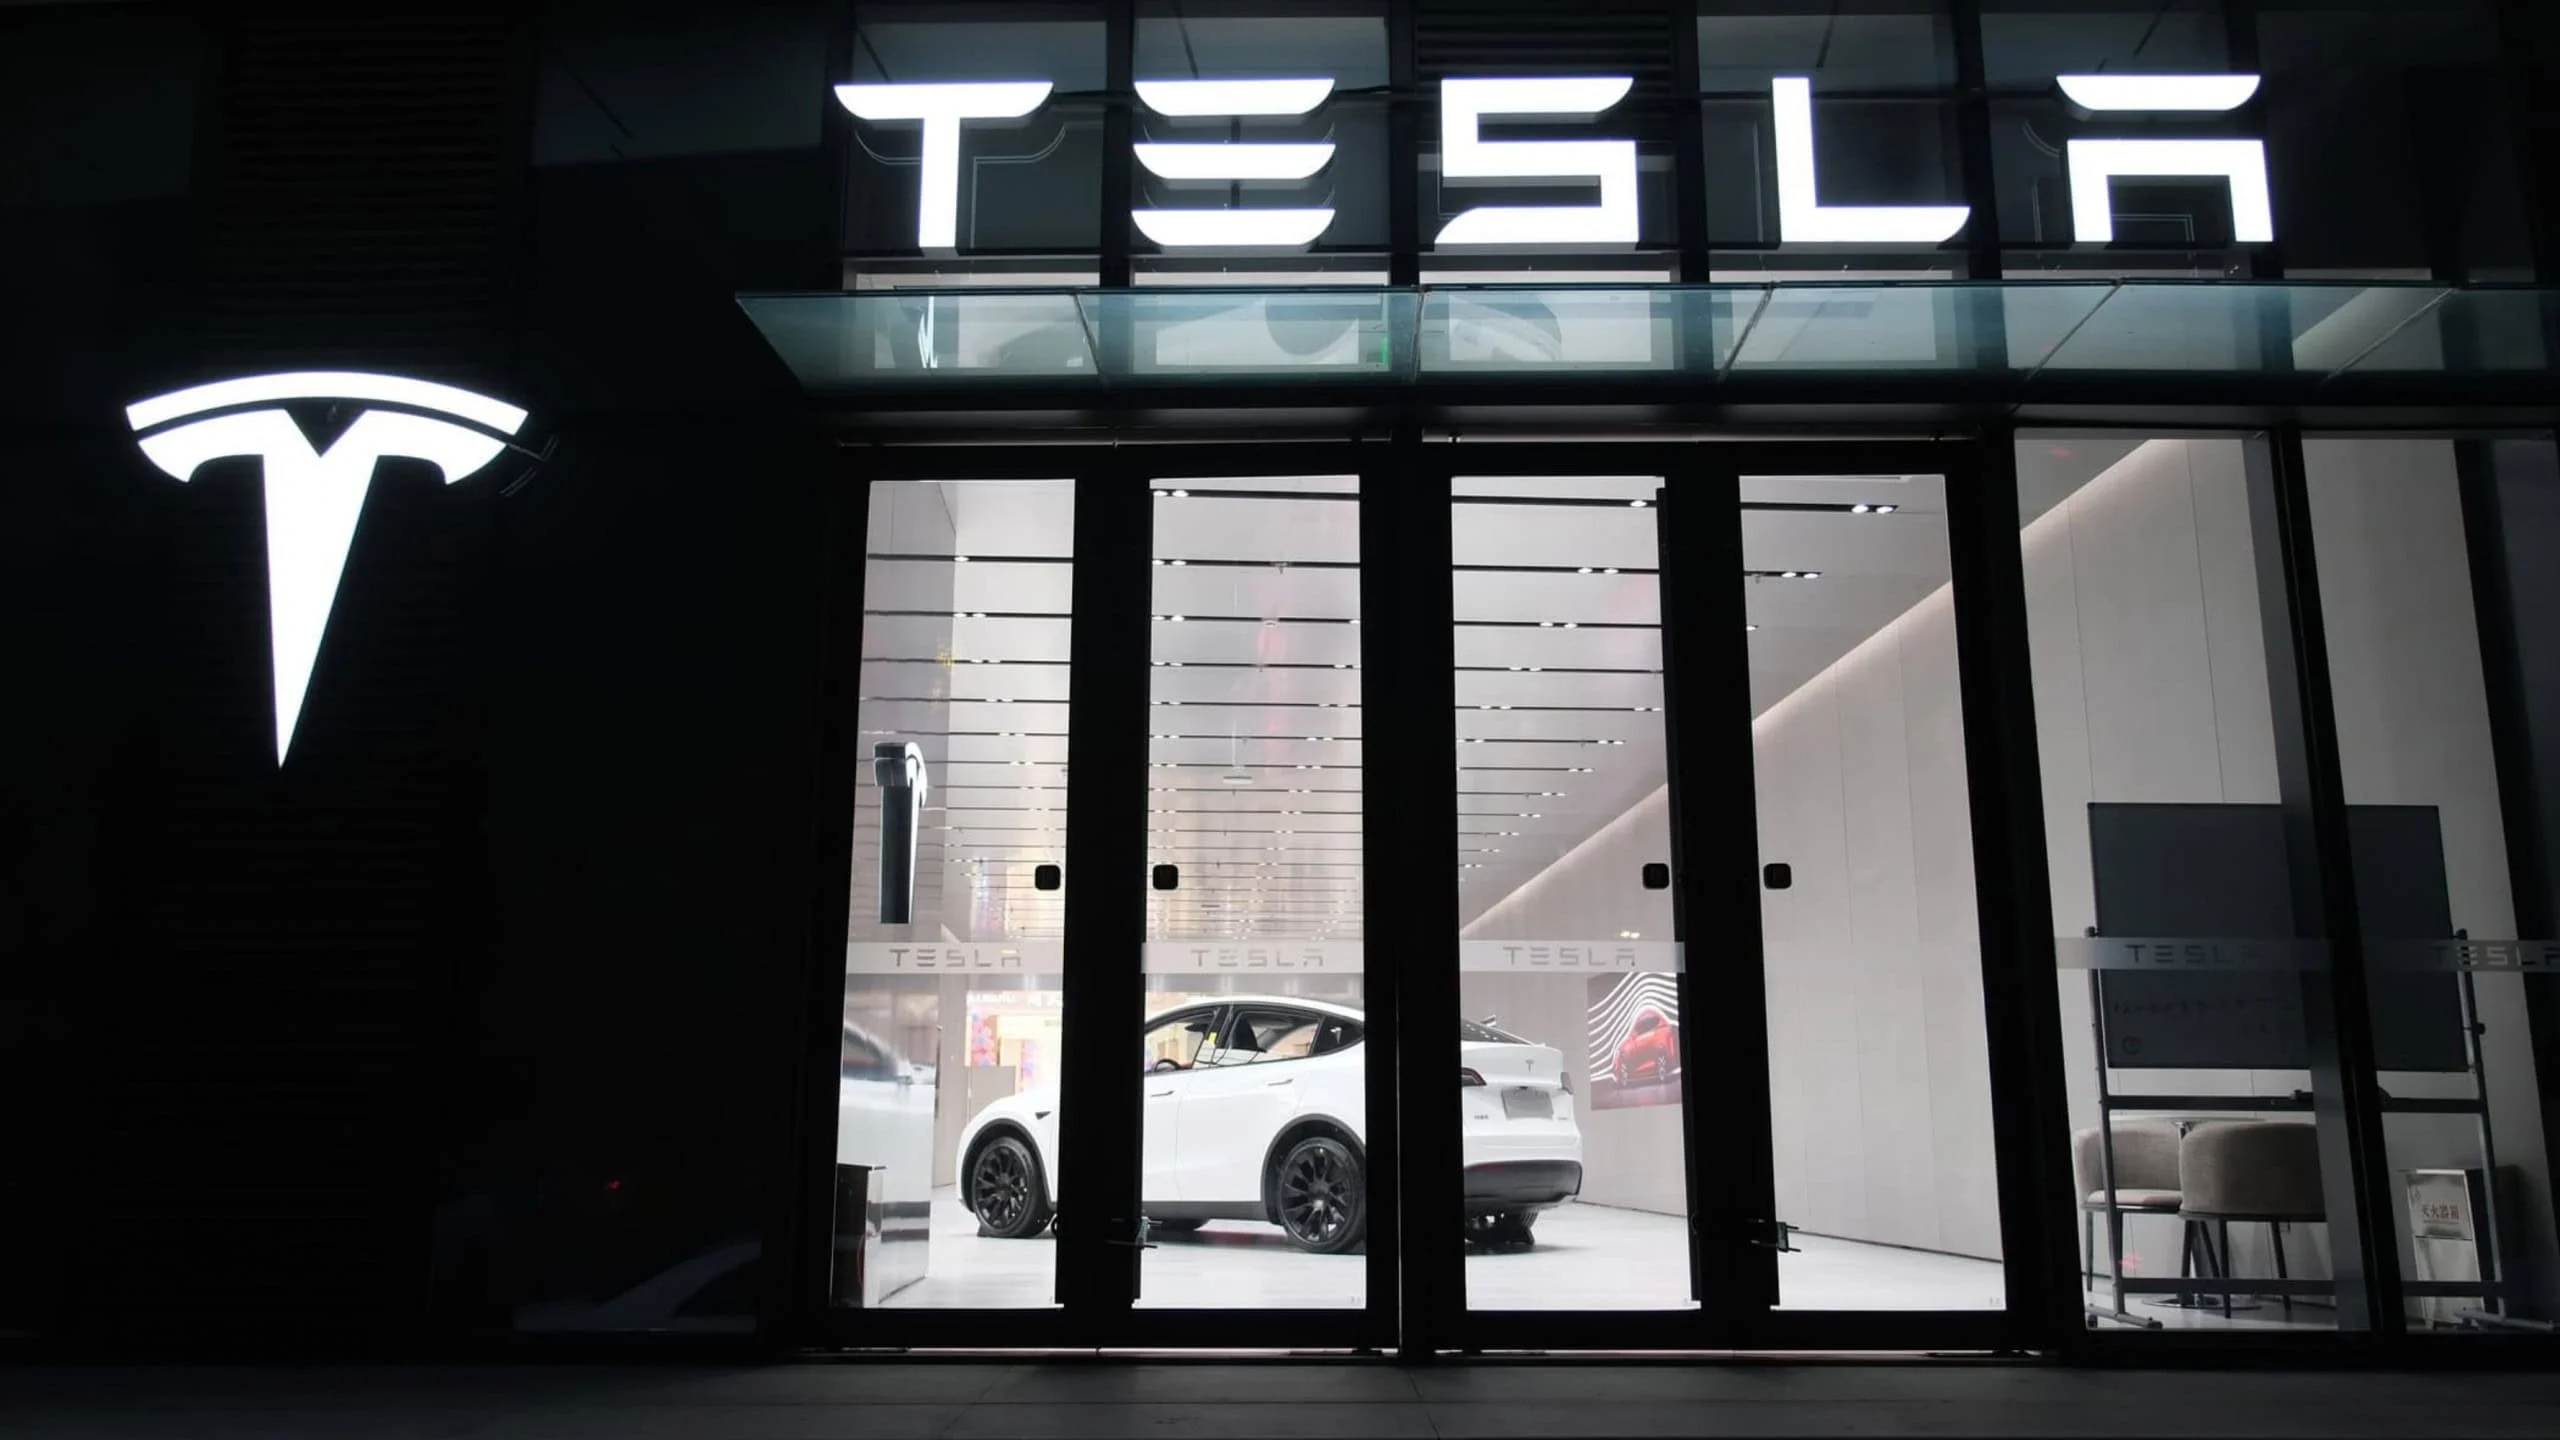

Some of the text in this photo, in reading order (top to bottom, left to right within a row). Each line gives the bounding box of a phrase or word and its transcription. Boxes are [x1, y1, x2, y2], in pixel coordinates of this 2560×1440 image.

[834, 72, 2274, 250] TESLA
[889, 948, 1022, 968] TESLA
[1190, 948, 1325, 968] TESLA
[1503, 946, 1636, 967] TESLA
